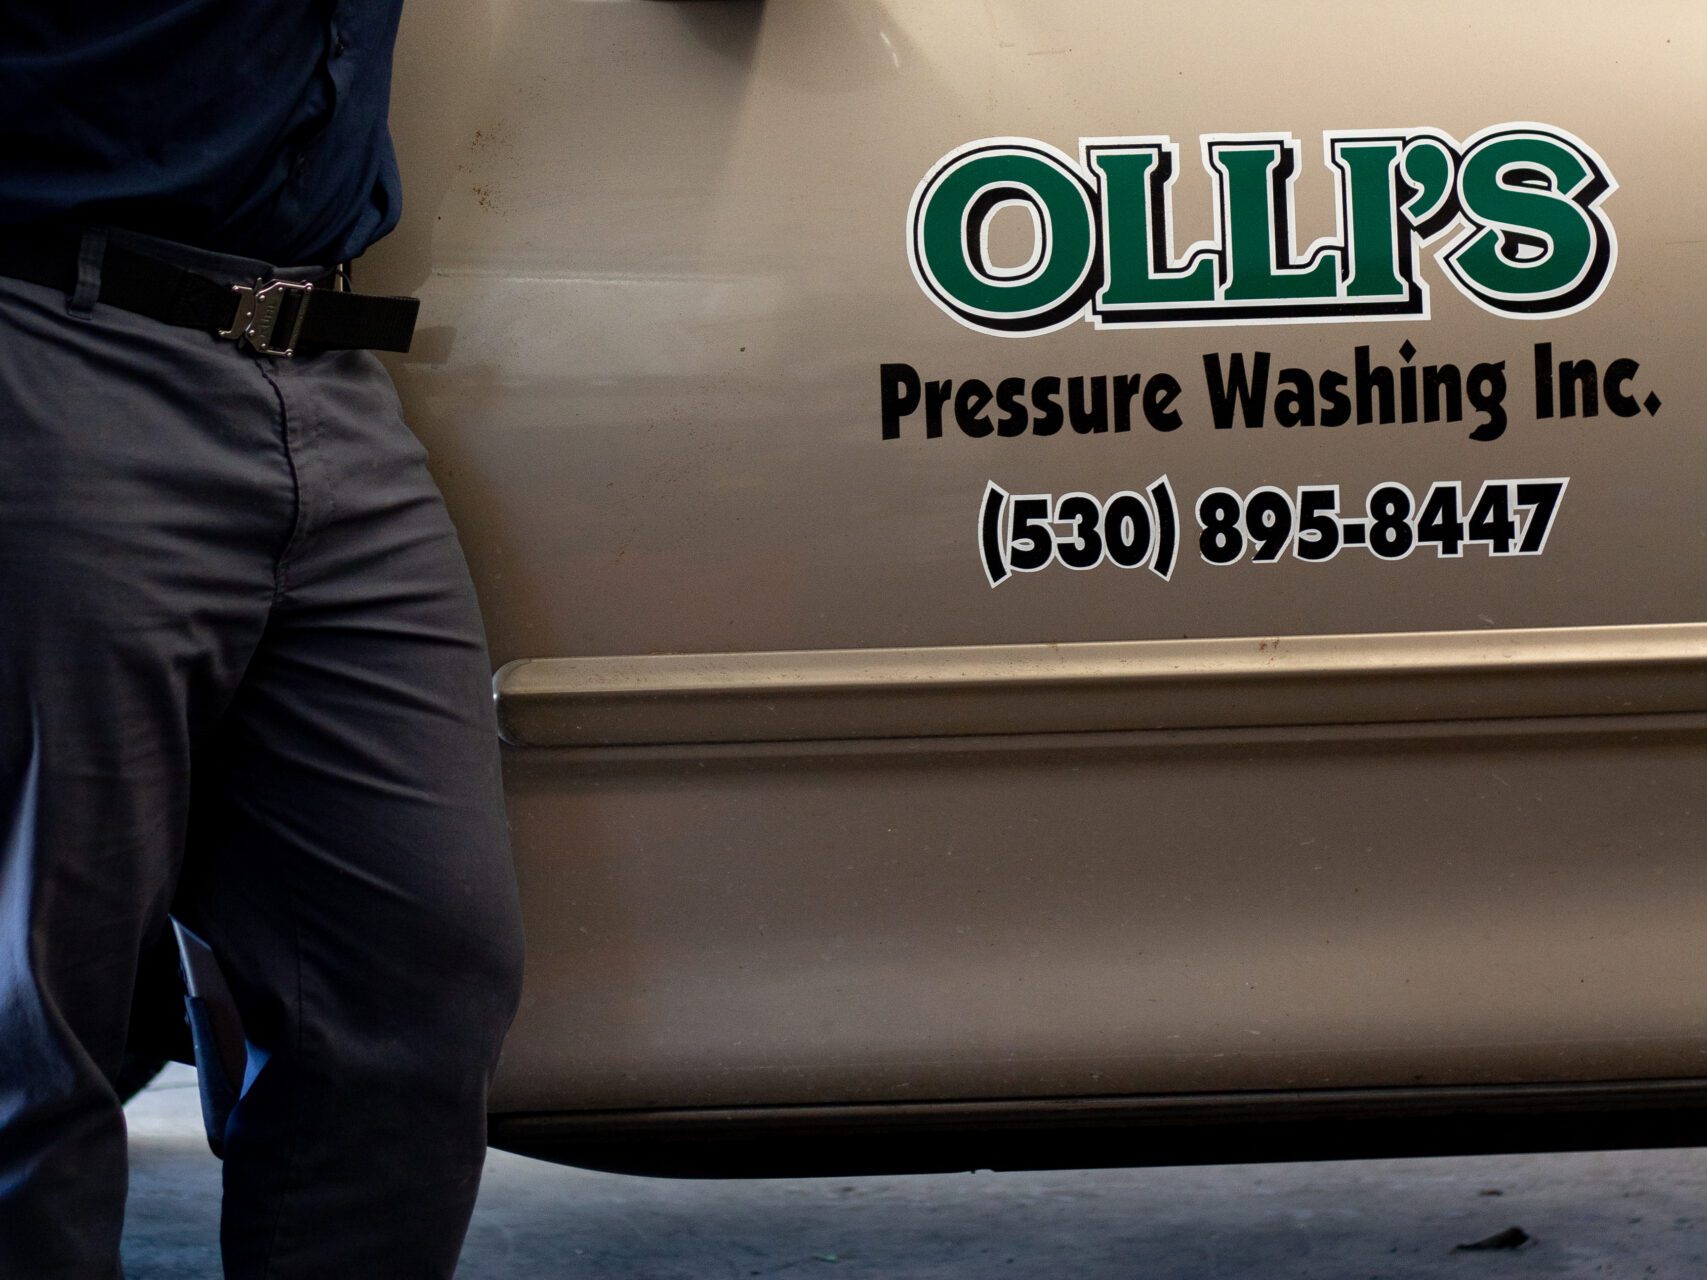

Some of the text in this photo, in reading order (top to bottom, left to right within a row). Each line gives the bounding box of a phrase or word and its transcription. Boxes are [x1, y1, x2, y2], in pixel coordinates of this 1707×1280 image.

[906, 122, 1620, 338] OLLI'S
[880, 339, 1663, 441] Pressure Washing Inc.
[978, 474, 1571, 588] (530) 895-8447
